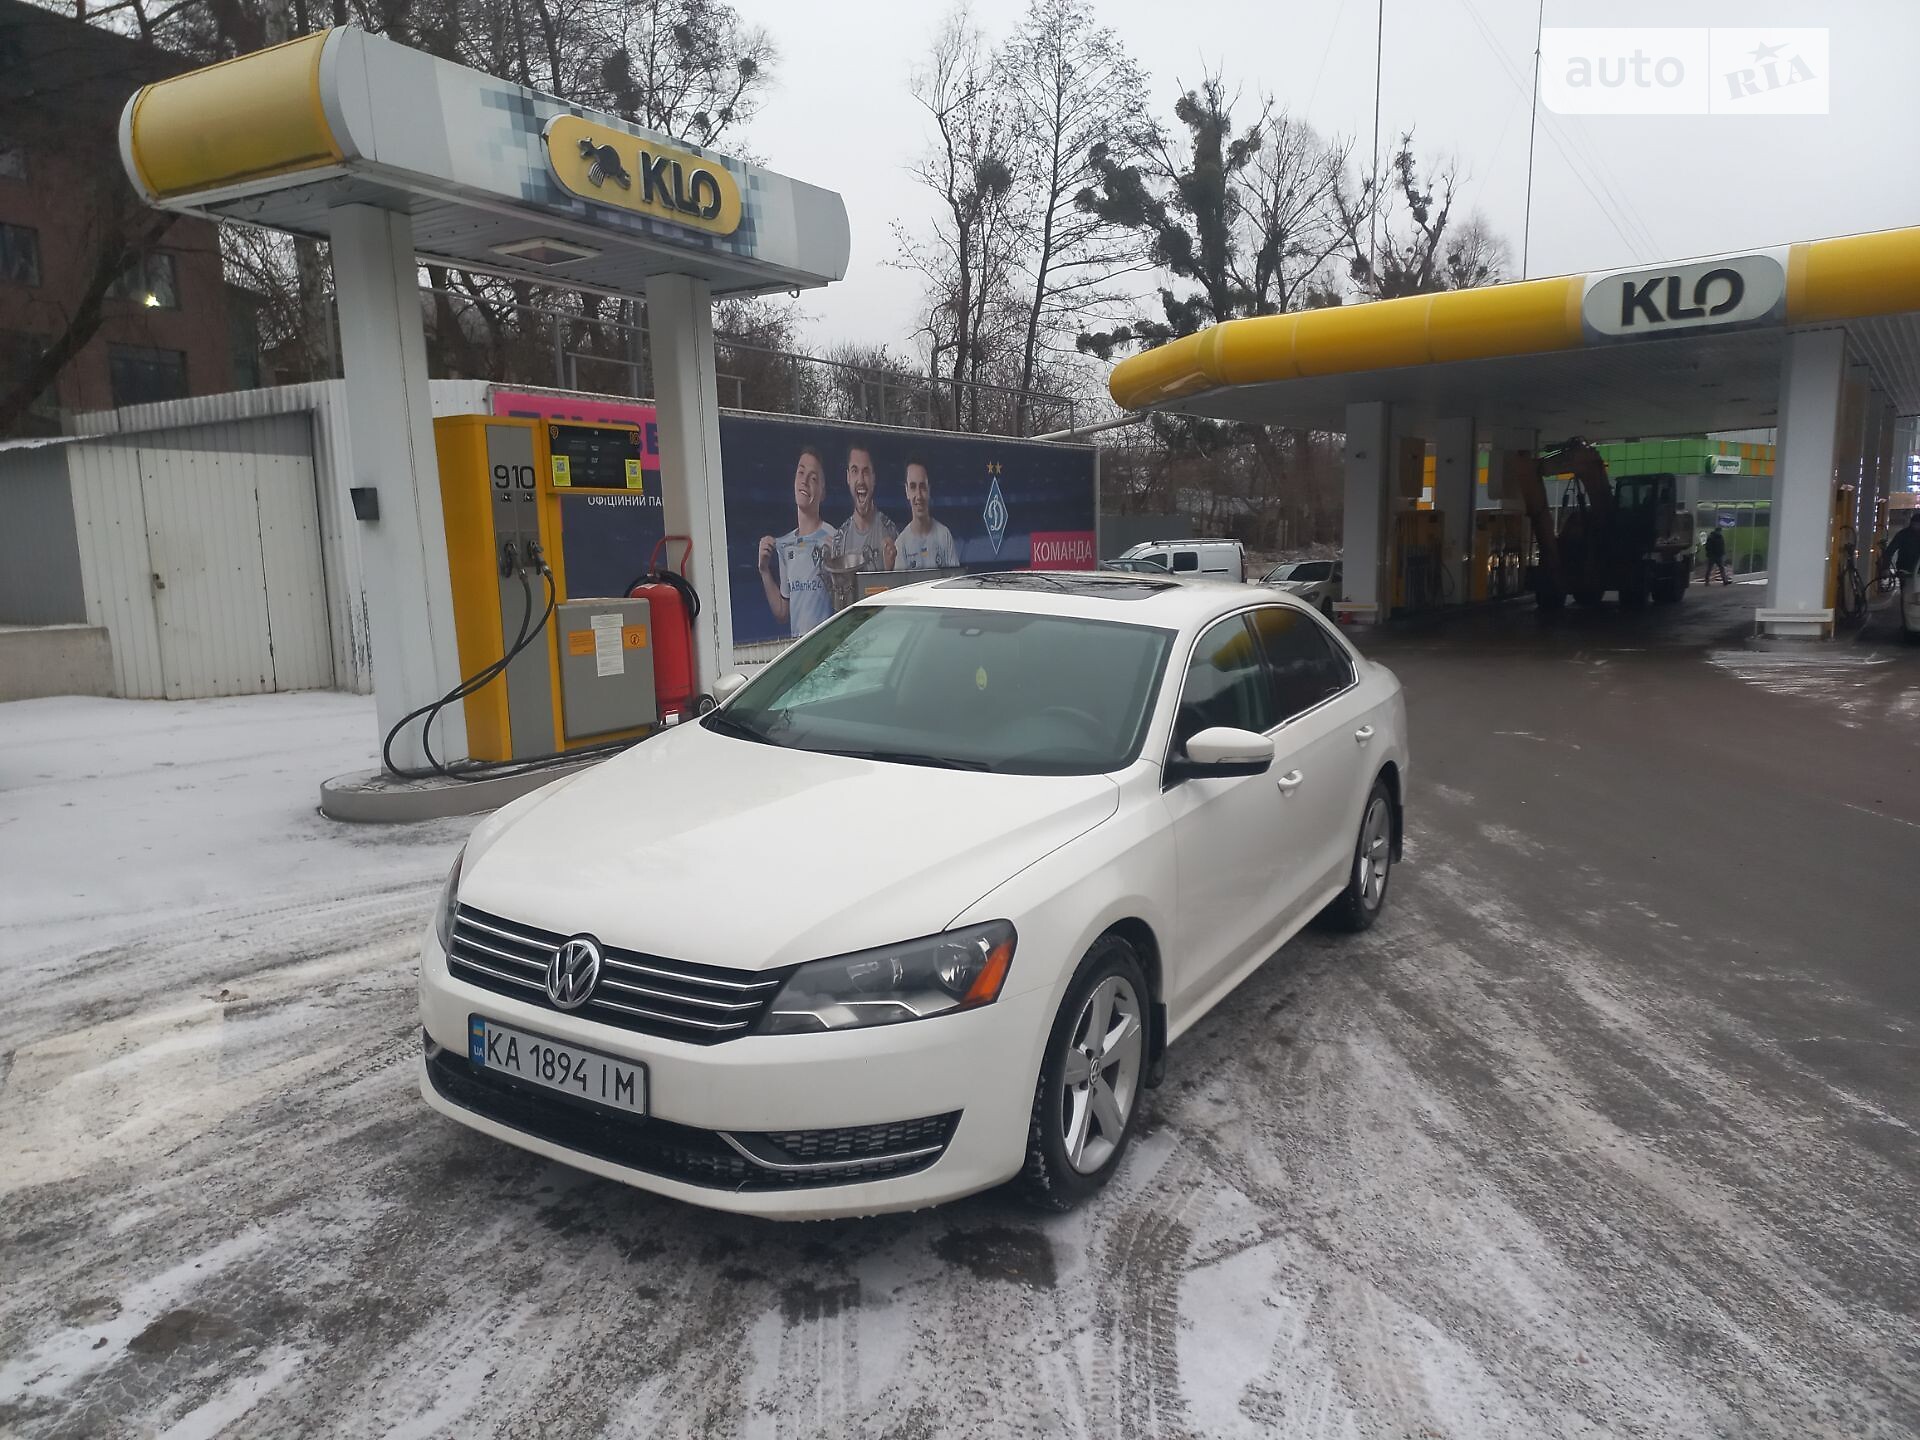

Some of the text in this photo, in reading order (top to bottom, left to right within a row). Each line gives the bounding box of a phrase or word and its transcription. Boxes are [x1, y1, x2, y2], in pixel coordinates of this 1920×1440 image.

[639, 150, 722, 220] KLO
[1621, 268, 1745, 328] KLO
[648, 496, 664, 507] ПА
[1033, 540, 1093, 563] КОМАНДА
[473, 1045, 484, 1058] UA
[487, 1030, 521, 1071] KA
[529, 1045, 588, 1092] 1894
